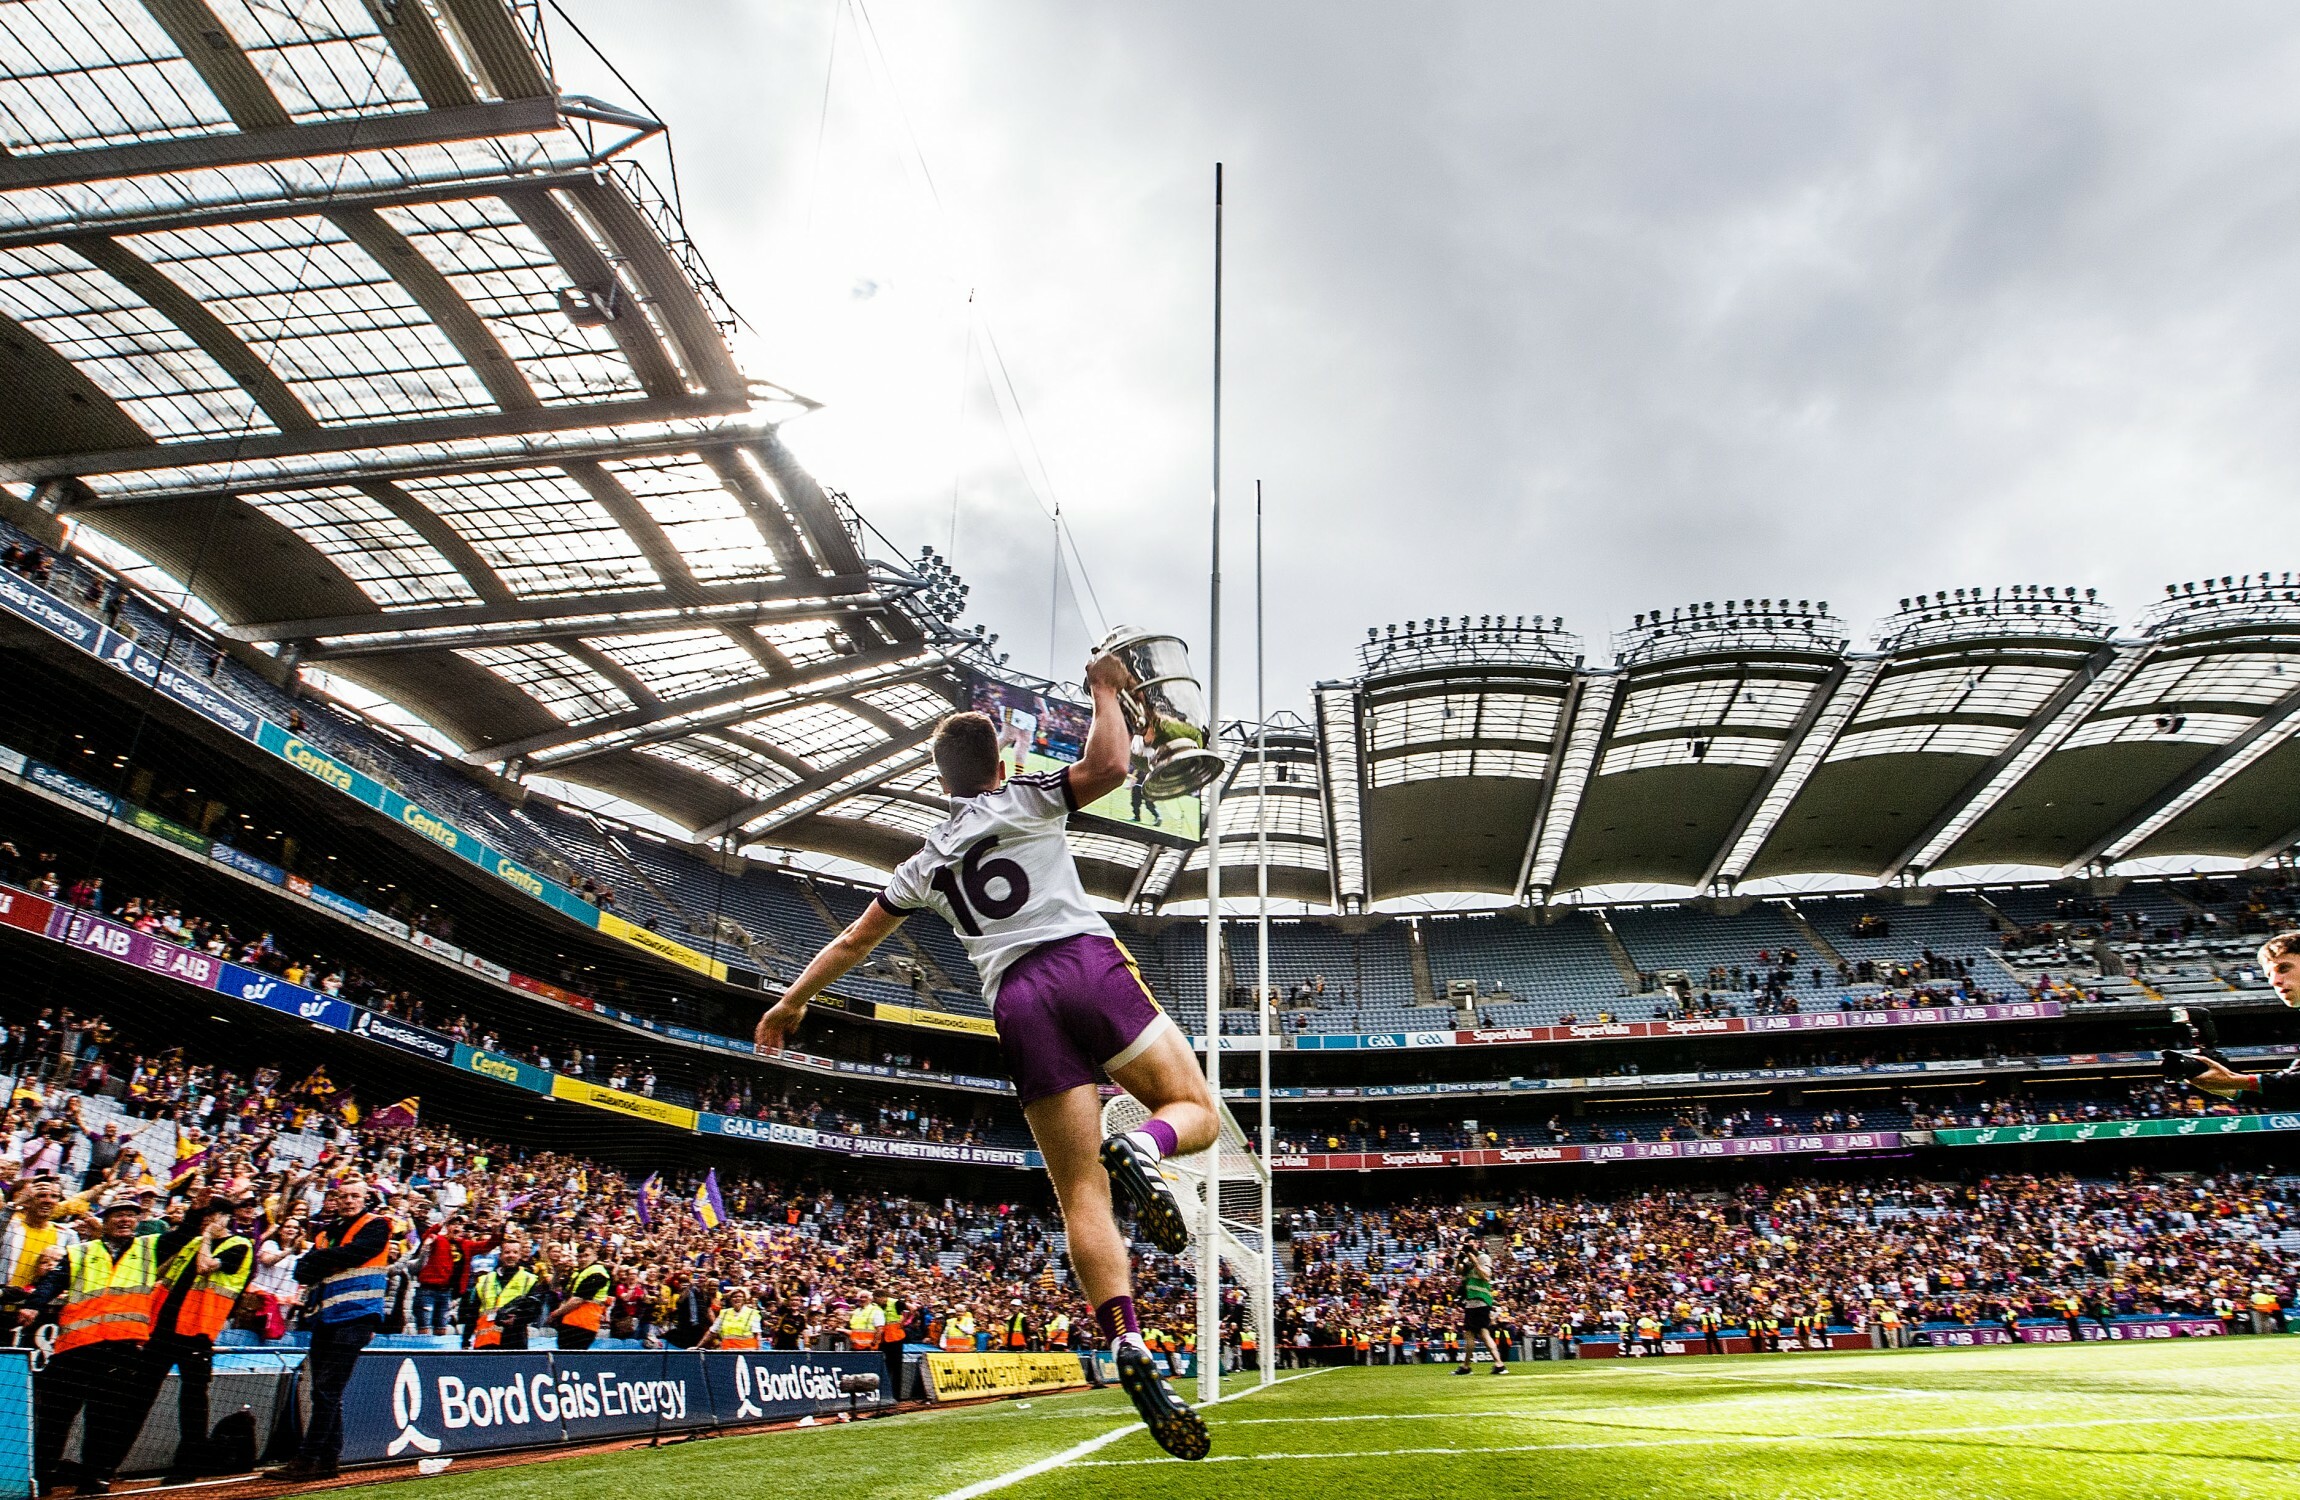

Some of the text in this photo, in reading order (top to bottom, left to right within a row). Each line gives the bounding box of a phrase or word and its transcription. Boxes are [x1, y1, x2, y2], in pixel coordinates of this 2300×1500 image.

[26, 595, 90, 640] Energy
[202, 694, 250, 731] Energy
[283, 739, 352, 790] Centra
[403, 804, 457, 848] Centra
[497, 859, 543, 896] Centra
[932, 835, 1030, 936] 16
[84, 924, 131, 956] AIB
[170, 953, 211, 982] AIB
[242, 976, 276, 999] eir
[300, 995, 331, 1017] eir
[2011, 1005, 2036, 1017] AIB
[1815, 1015, 1839, 1026] AIB
[1864, 1013, 1888, 1025] AIB
[1913, 1010, 1937, 1022] AIB
[1962, 1008, 1987, 1020] AIB
[1667, 1019, 1728, 1034] SuperValu
[1767, 1017, 1791, 1029] AIB
[1416, 1033, 1444, 1045] GAA
[1473, 1029, 1533, 1043] SuperValu
[1570, 1025, 1630, 1039] SuperValu
[1368, 1035, 1397, 1047] GAA
[471, 1052, 518, 1082] Centra
[723, 1117, 769, 1140] GAA.ie
[1700, 1142, 1723, 1154] AIB
[1750, 1140, 1773, 1152] AIB
[1800, 1137, 1823, 1149] AIB
[1850, 1135, 1873, 1147] AIB
[815, 1132, 1025, 1165] CROKE PARK MEETINGS & EVENTS
[1500, 1148, 1561, 1163] SuperValu
[1600, 1147, 1625, 1158] AIB
[1650, 1144, 1673, 1156] AIB
[1271, 1156, 1308, 1167] erValu
[1382, 1153, 1443, 1167] SuperValu
[2046, 1328, 2071, 1342] AIB
[2096, 1327, 2123, 1340] AB
[2145, 1326, 2170, 1337] AIB
[755, 1365, 802, 1401] Bord
[800, 1365, 837, 1400] Gáis
[437, 1371, 686, 1428] Bord Gáis Energy
